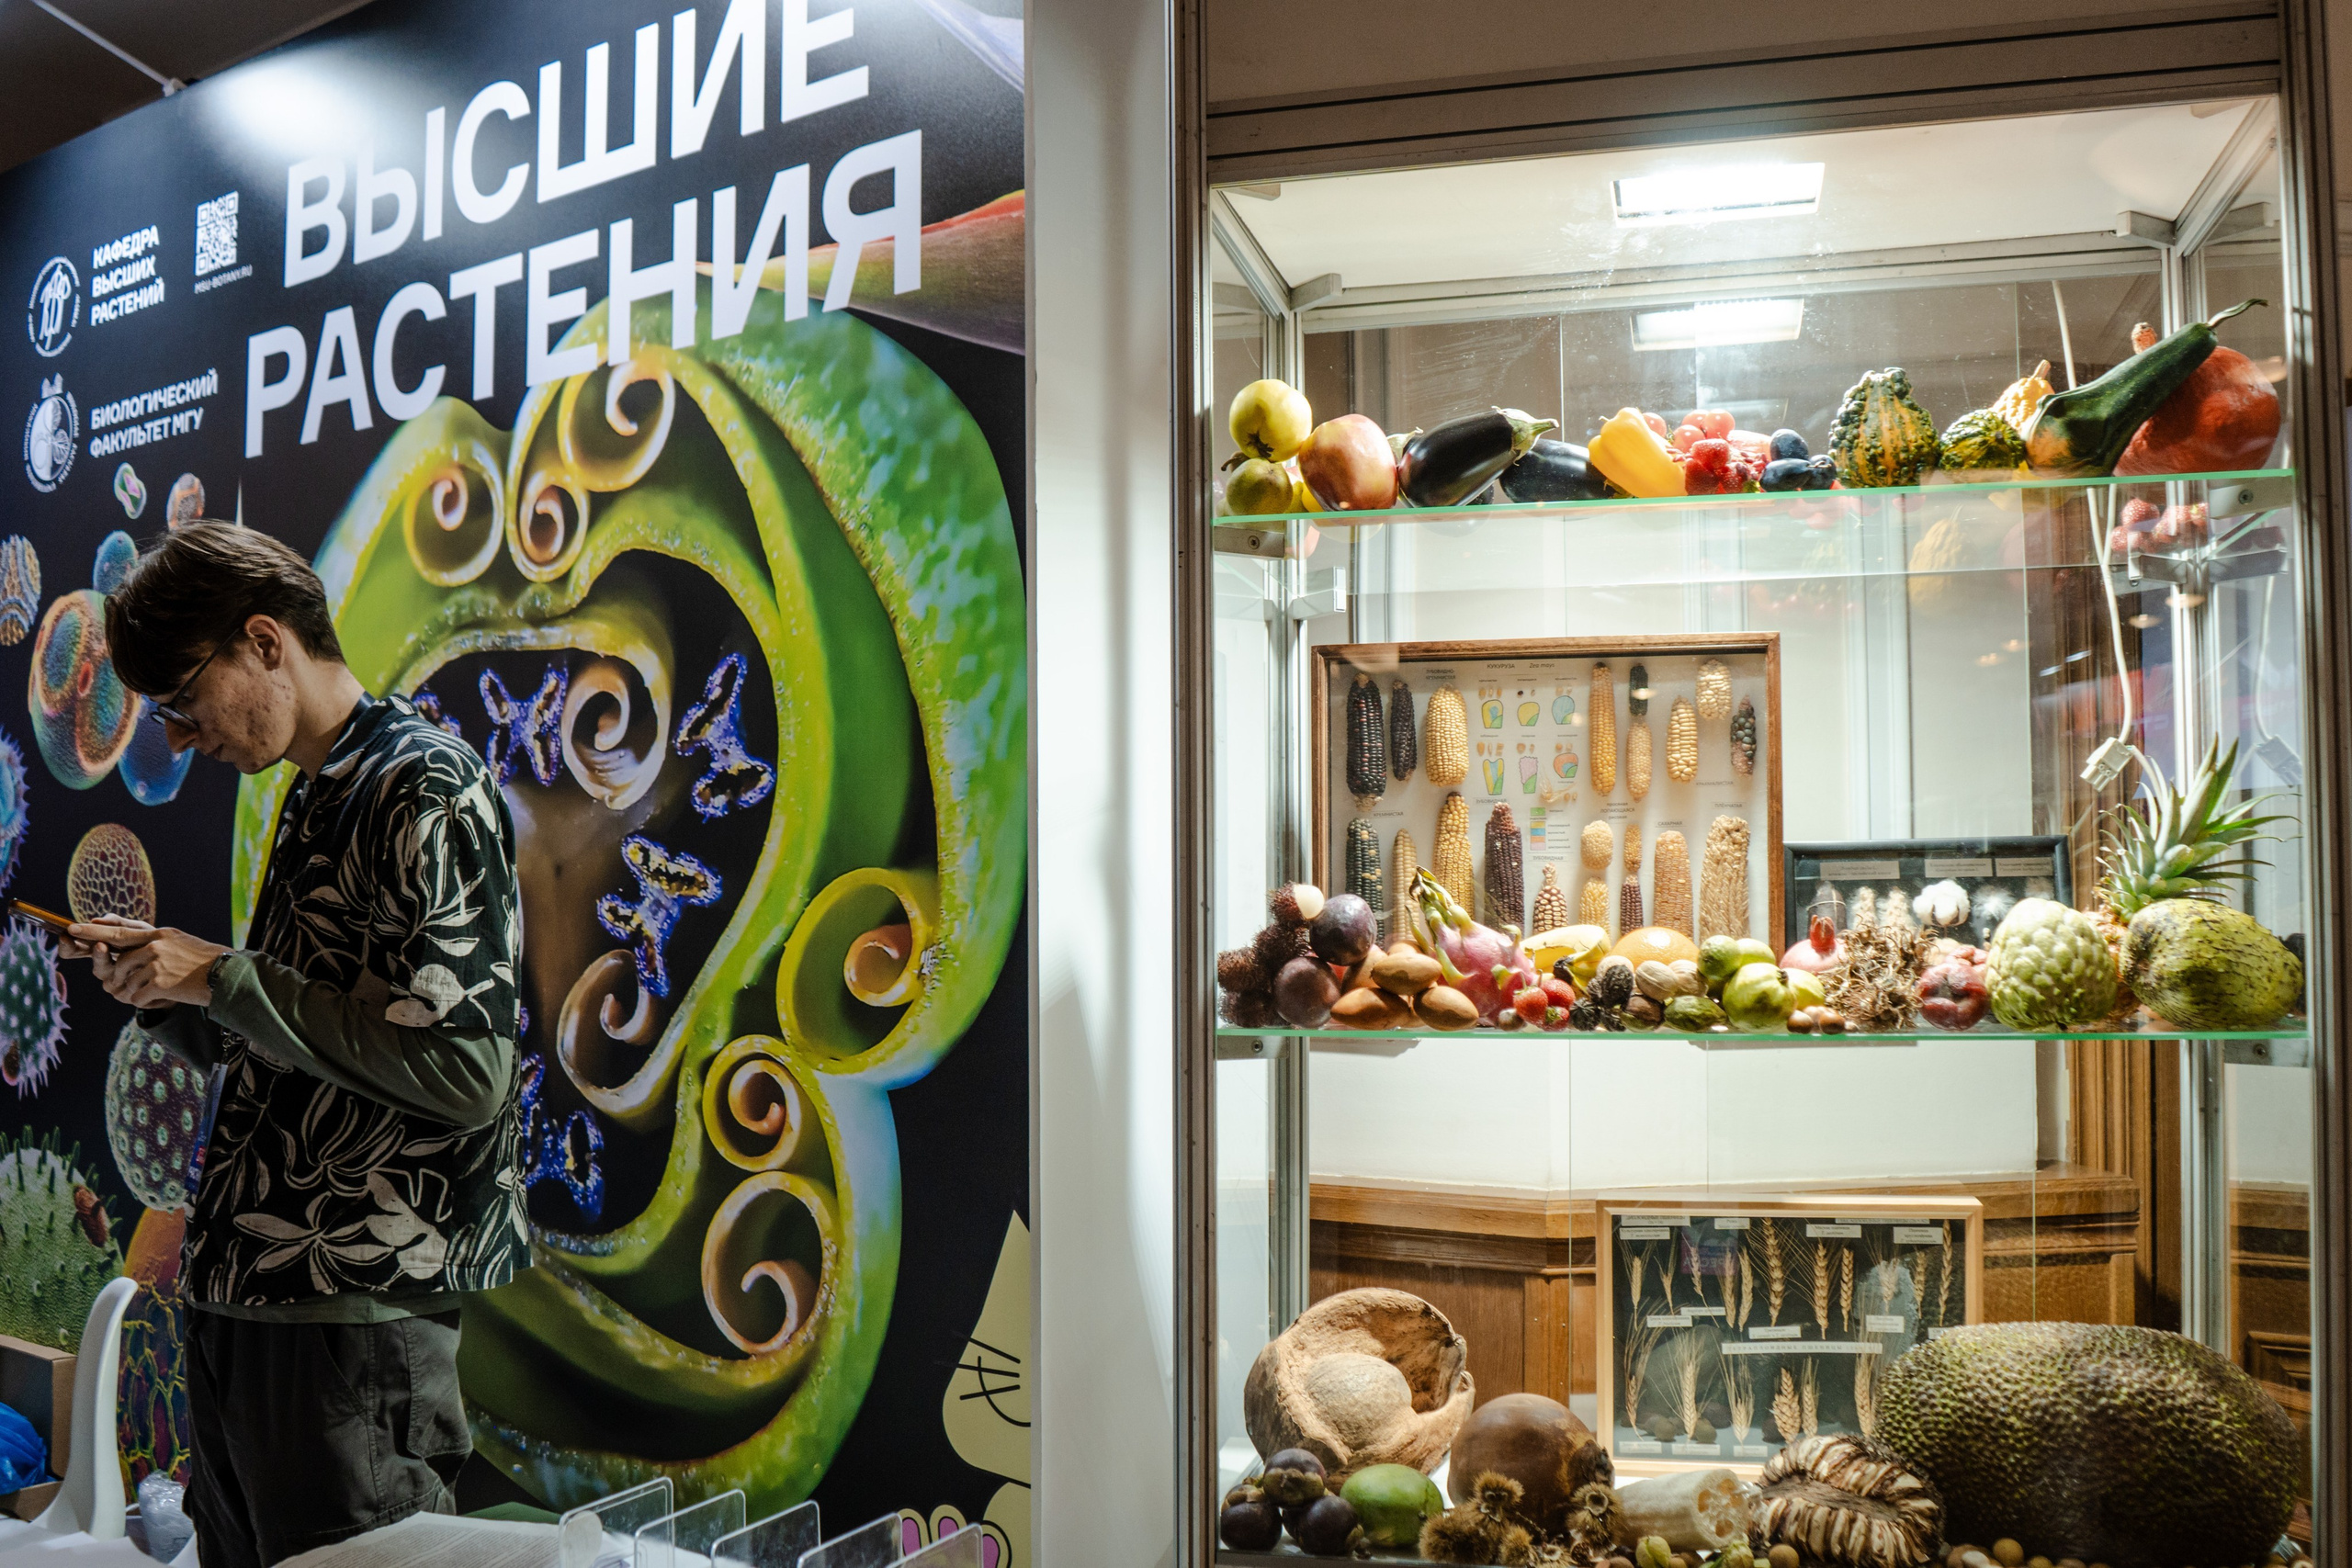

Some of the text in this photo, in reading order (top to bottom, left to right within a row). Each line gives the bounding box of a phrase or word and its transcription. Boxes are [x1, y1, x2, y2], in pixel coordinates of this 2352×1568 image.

[283, 0, 870, 288] ВЫСШИЕ
[93, 225, 160, 269] КАФЕДРА
[90, 276, 164, 326] РАСТЕНИЙ
[92, 255, 156, 298] ВЫСШИХ
[194, 265, 253, 294] MSU-BOTANY.RU
[245, 130, 922, 457] РАСТЕНИЯ
[91, 367, 219, 430] БИОЛОГИЧЕСКИЙ
[90, 407, 204, 457] ФАКУЛЬТЕТ МГУ
